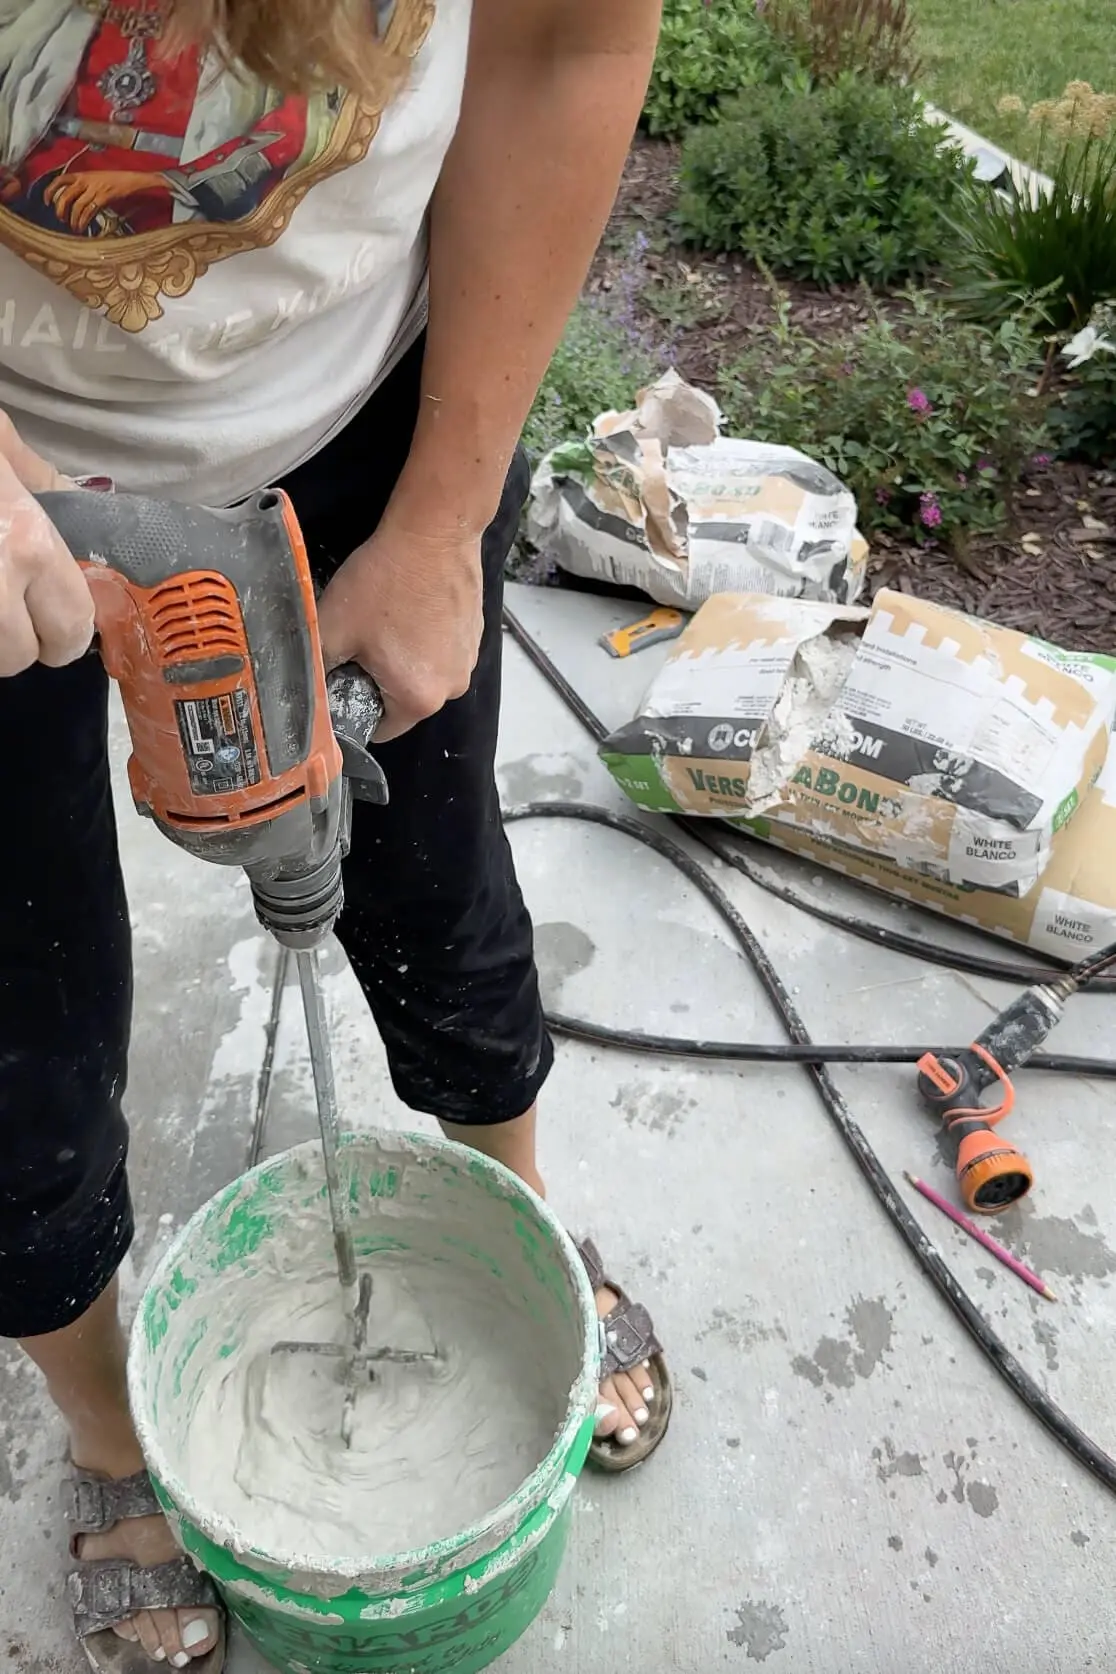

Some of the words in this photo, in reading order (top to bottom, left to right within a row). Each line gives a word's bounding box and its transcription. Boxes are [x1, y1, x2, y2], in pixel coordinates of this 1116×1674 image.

[973, 836, 1013, 850] WHITE
[966, 846, 1017, 861] BLANCO
[1054, 914, 1092, 933] WHITE
[1045, 925, 1093, 943] BLANCO
